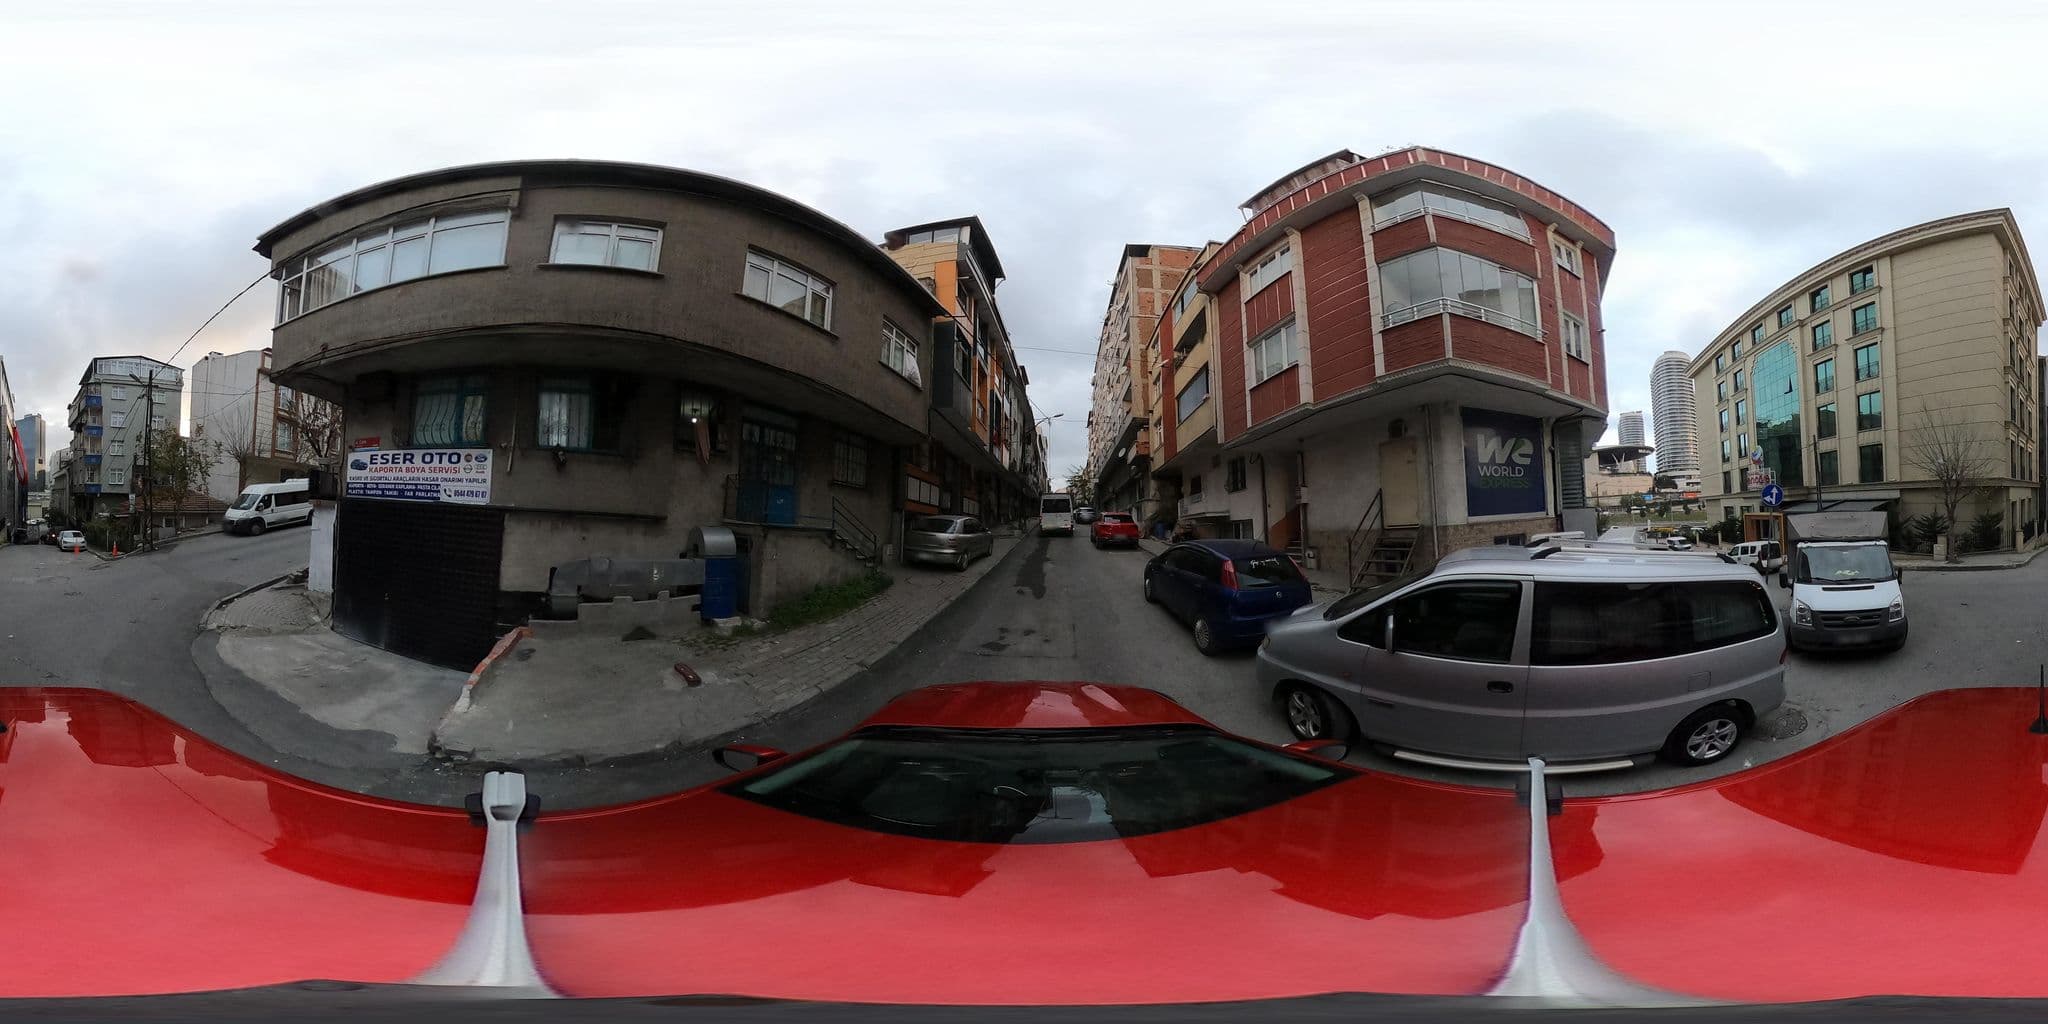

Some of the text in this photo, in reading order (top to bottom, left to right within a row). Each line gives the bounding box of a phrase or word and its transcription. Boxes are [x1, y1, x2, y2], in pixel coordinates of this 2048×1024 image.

[370, 453, 414, 464] ESER
[422, 452, 461, 464] OTO
[1478, 465, 1524, 477] WORLD
